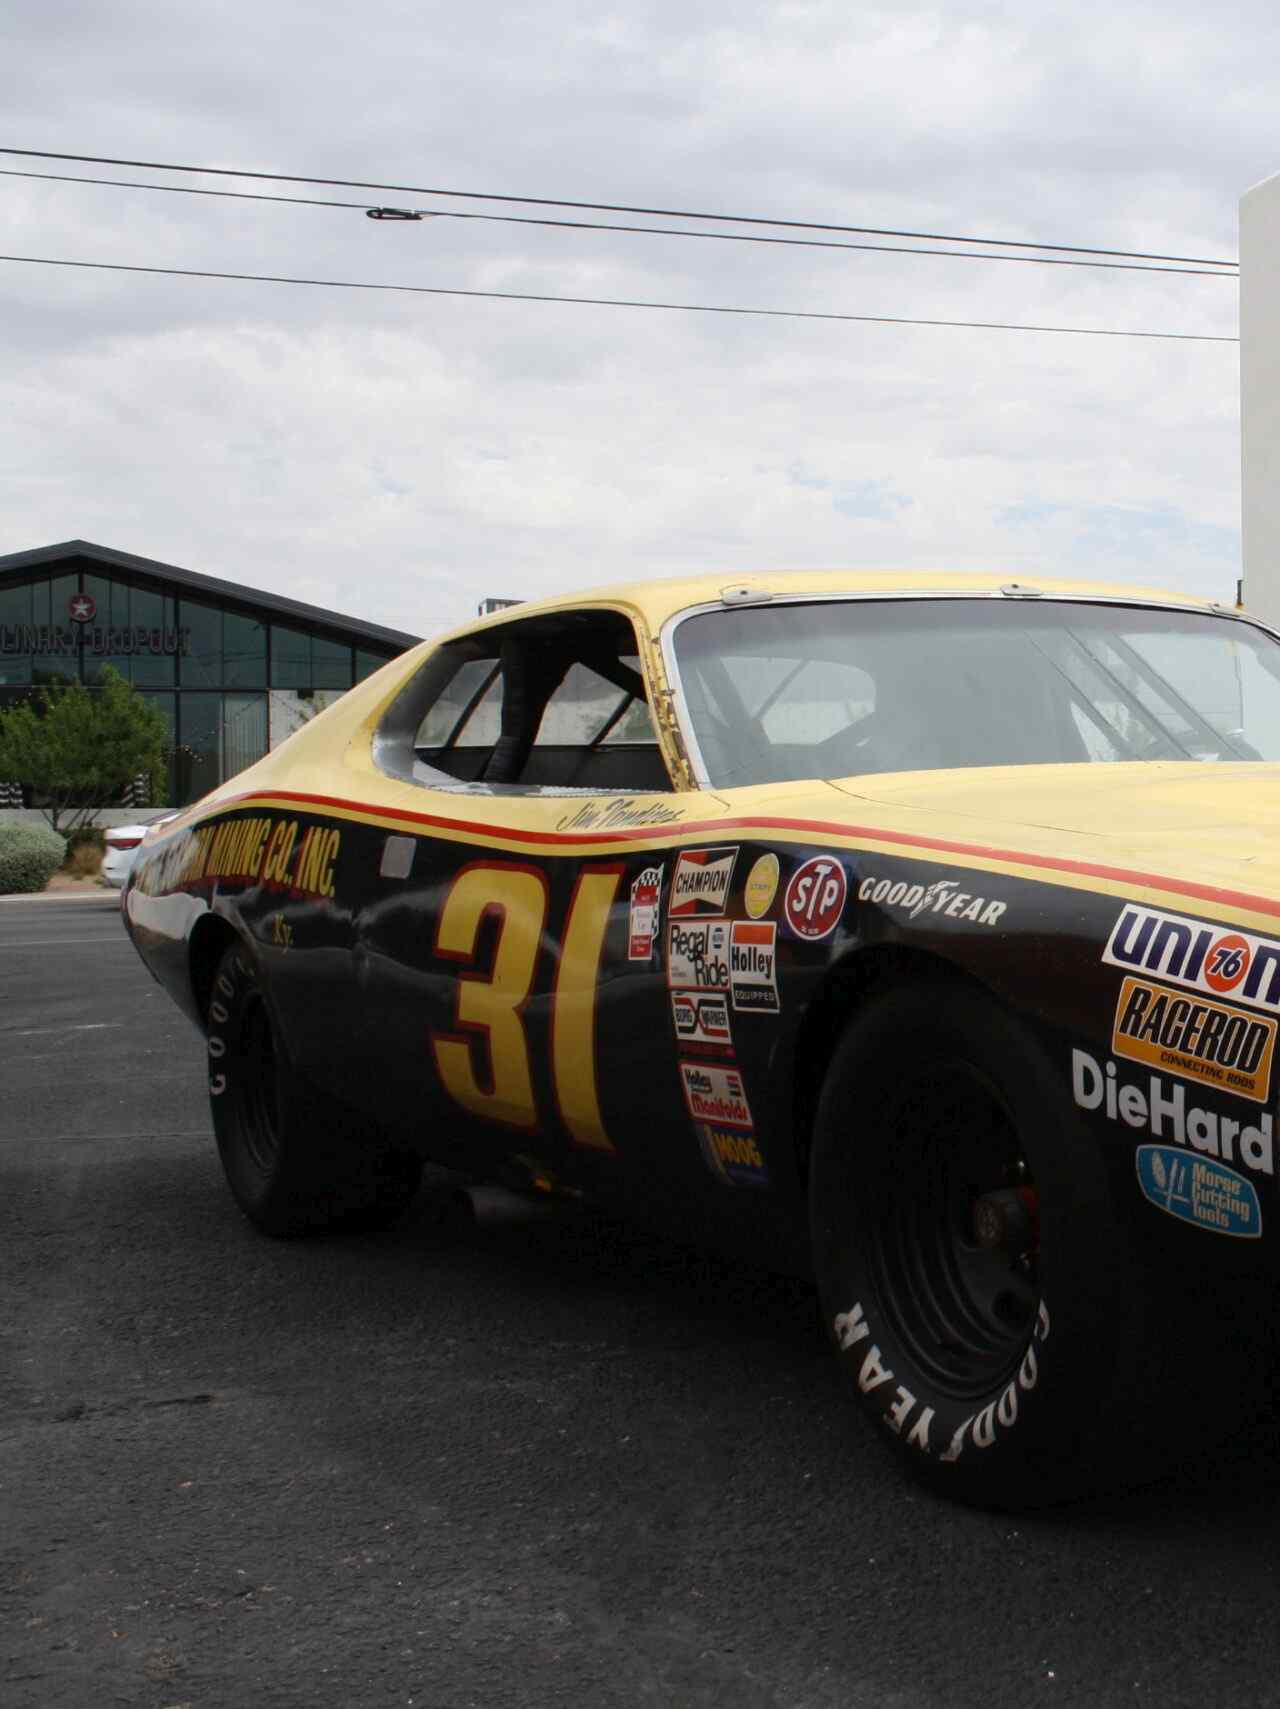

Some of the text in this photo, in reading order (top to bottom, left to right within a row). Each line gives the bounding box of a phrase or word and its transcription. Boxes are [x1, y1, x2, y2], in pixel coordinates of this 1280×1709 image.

[206, 818, 272, 877] MINING
[296, 825, 341, 898] INC.
[675, 870, 729, 894] CHAMPION
[791, 863, 840, 921] STP
[858, 877, 1008, 926] GOODYEAR
[670, 925, 710, 961] Regal
[731, 946, 773, 979] Holley
[1210, 946, 1243, 979] 76
[694, 955, 729, 987] Ride
[431, 859, 626, 1157] 31
[1119, 987, 1271, 1075] RACEROD
[1160, 1051, 1256, 1091] CONNECTING RODS
[1071, 1047, 1275, 1176] DieHard
[1191, 1182, 1250, 1222] Cutting
